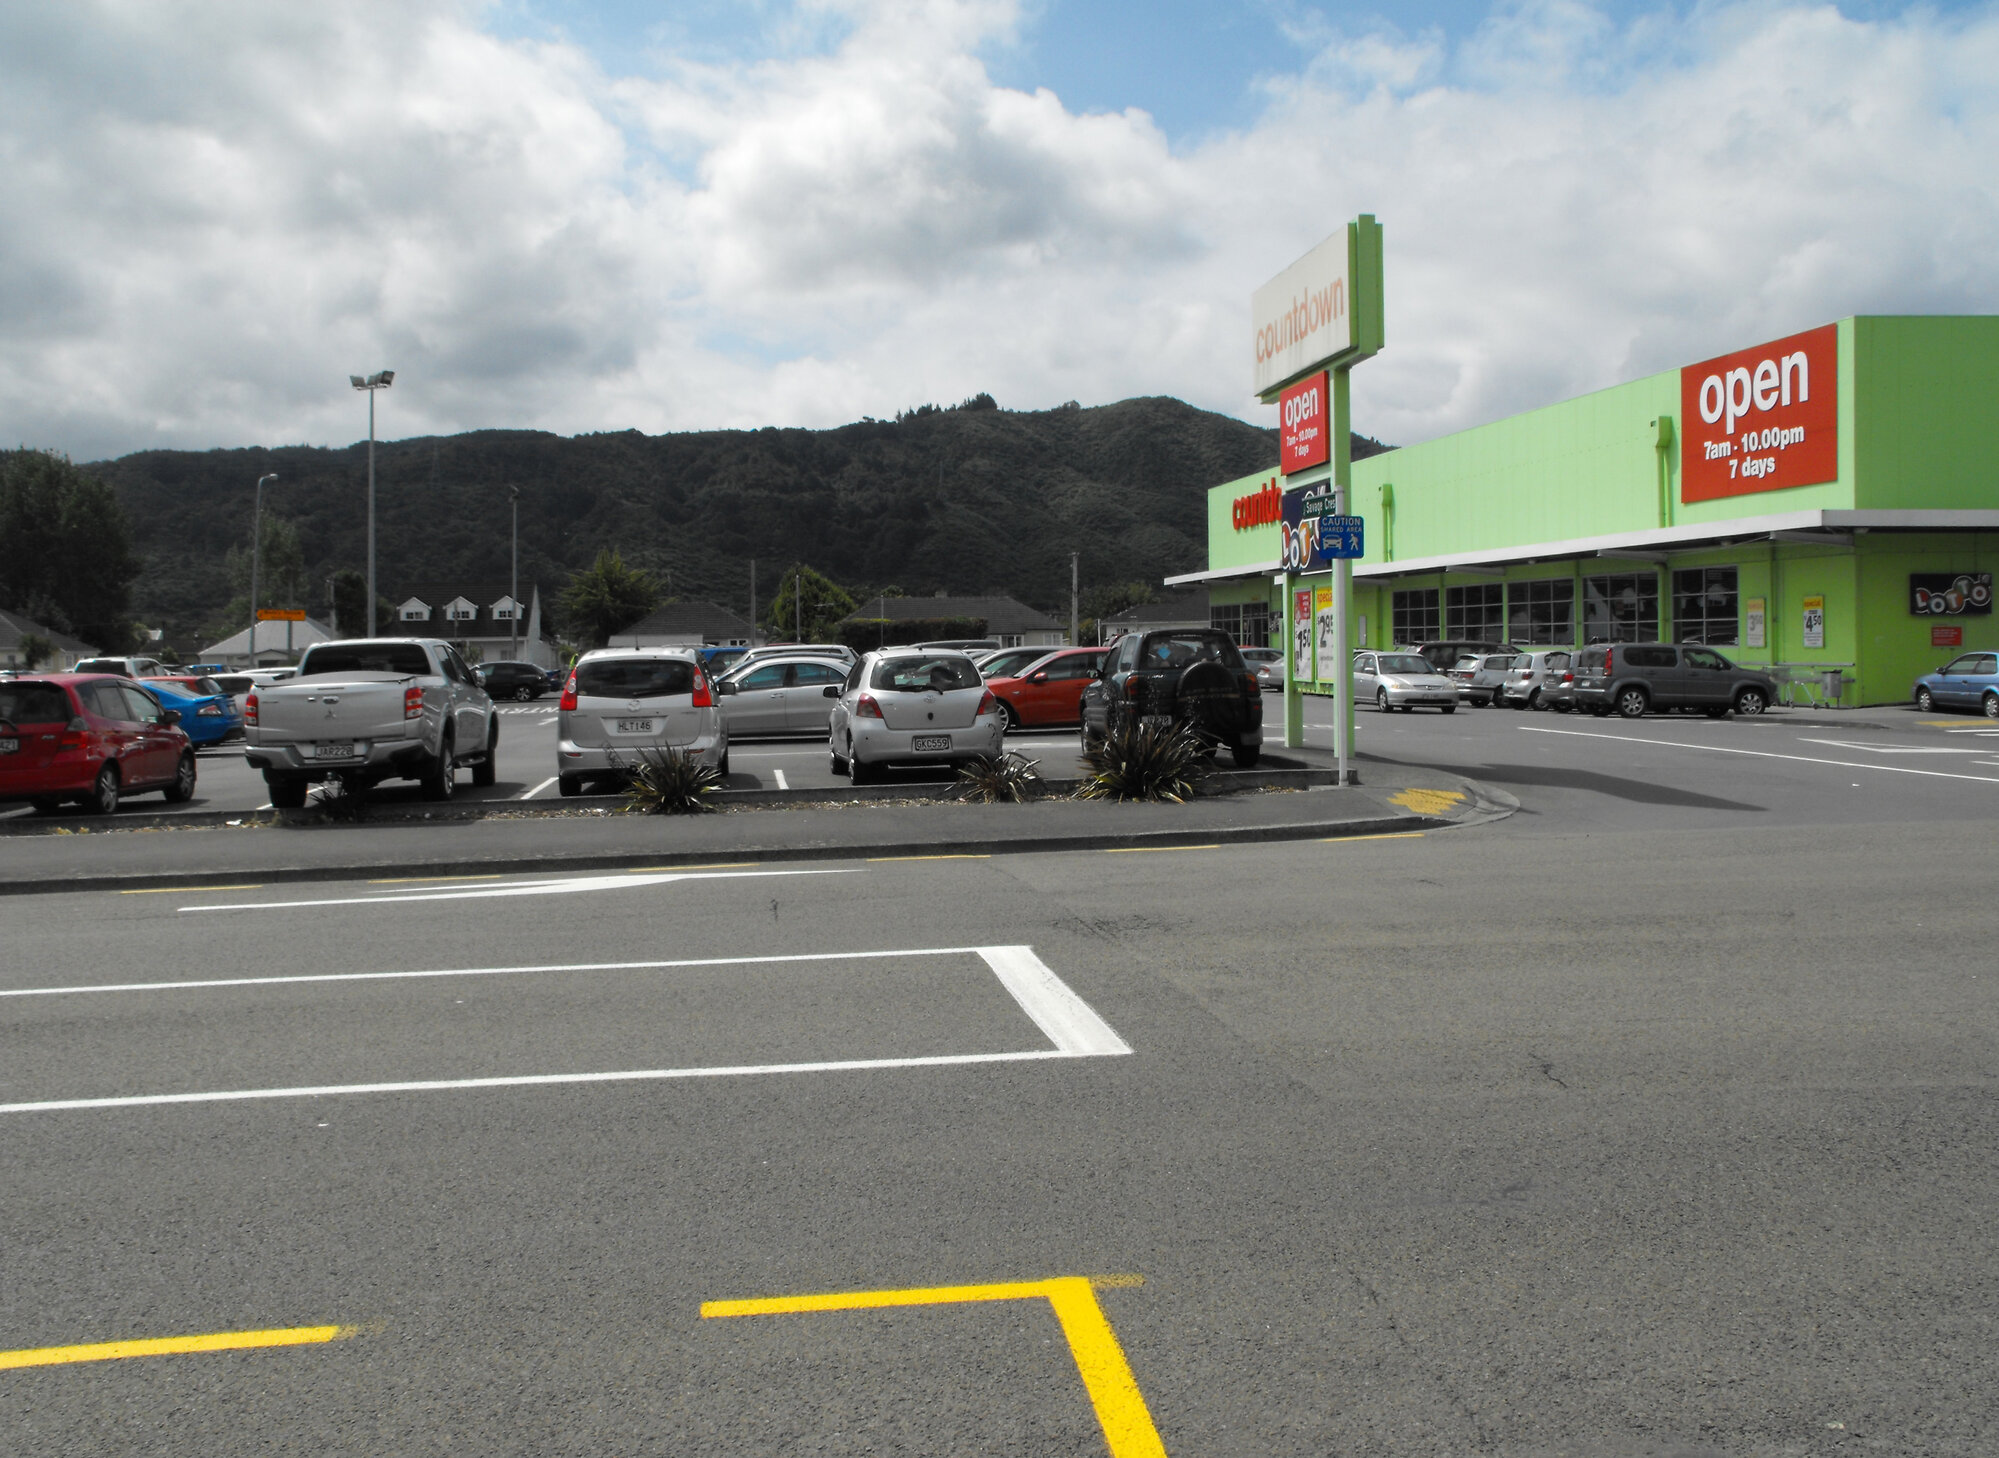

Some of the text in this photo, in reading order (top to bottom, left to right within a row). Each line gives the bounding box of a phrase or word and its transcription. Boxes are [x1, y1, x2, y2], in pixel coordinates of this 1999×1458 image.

[1256, 277, 1344, 364] countdown
[1699, 350, 1809, 435] open
[1285, 387, 1318, 433] open
[1286, 435, 1296, 447] 7am
[1299, 427, 1318, 442] 10.00pm
[1703, 440, 1731, 460] 7am
[1741, 425, 1805, 453] 10.00pm
[1299, 444, 1309, 456] days
[1729, 456, 1776, 479] 7 days
[1306, 498, 1336, 515] Savage Cres
[1322, 517, 1361, 526] CAUTION
[1282, 520, 1320, 568] LOT
[1915, 577, 1989, 614] LOTTO
[498, 706, 559, 714] NTRY
[618, 720, 651, 731] HLT146
[916, 739, 948, 749] GKC559
